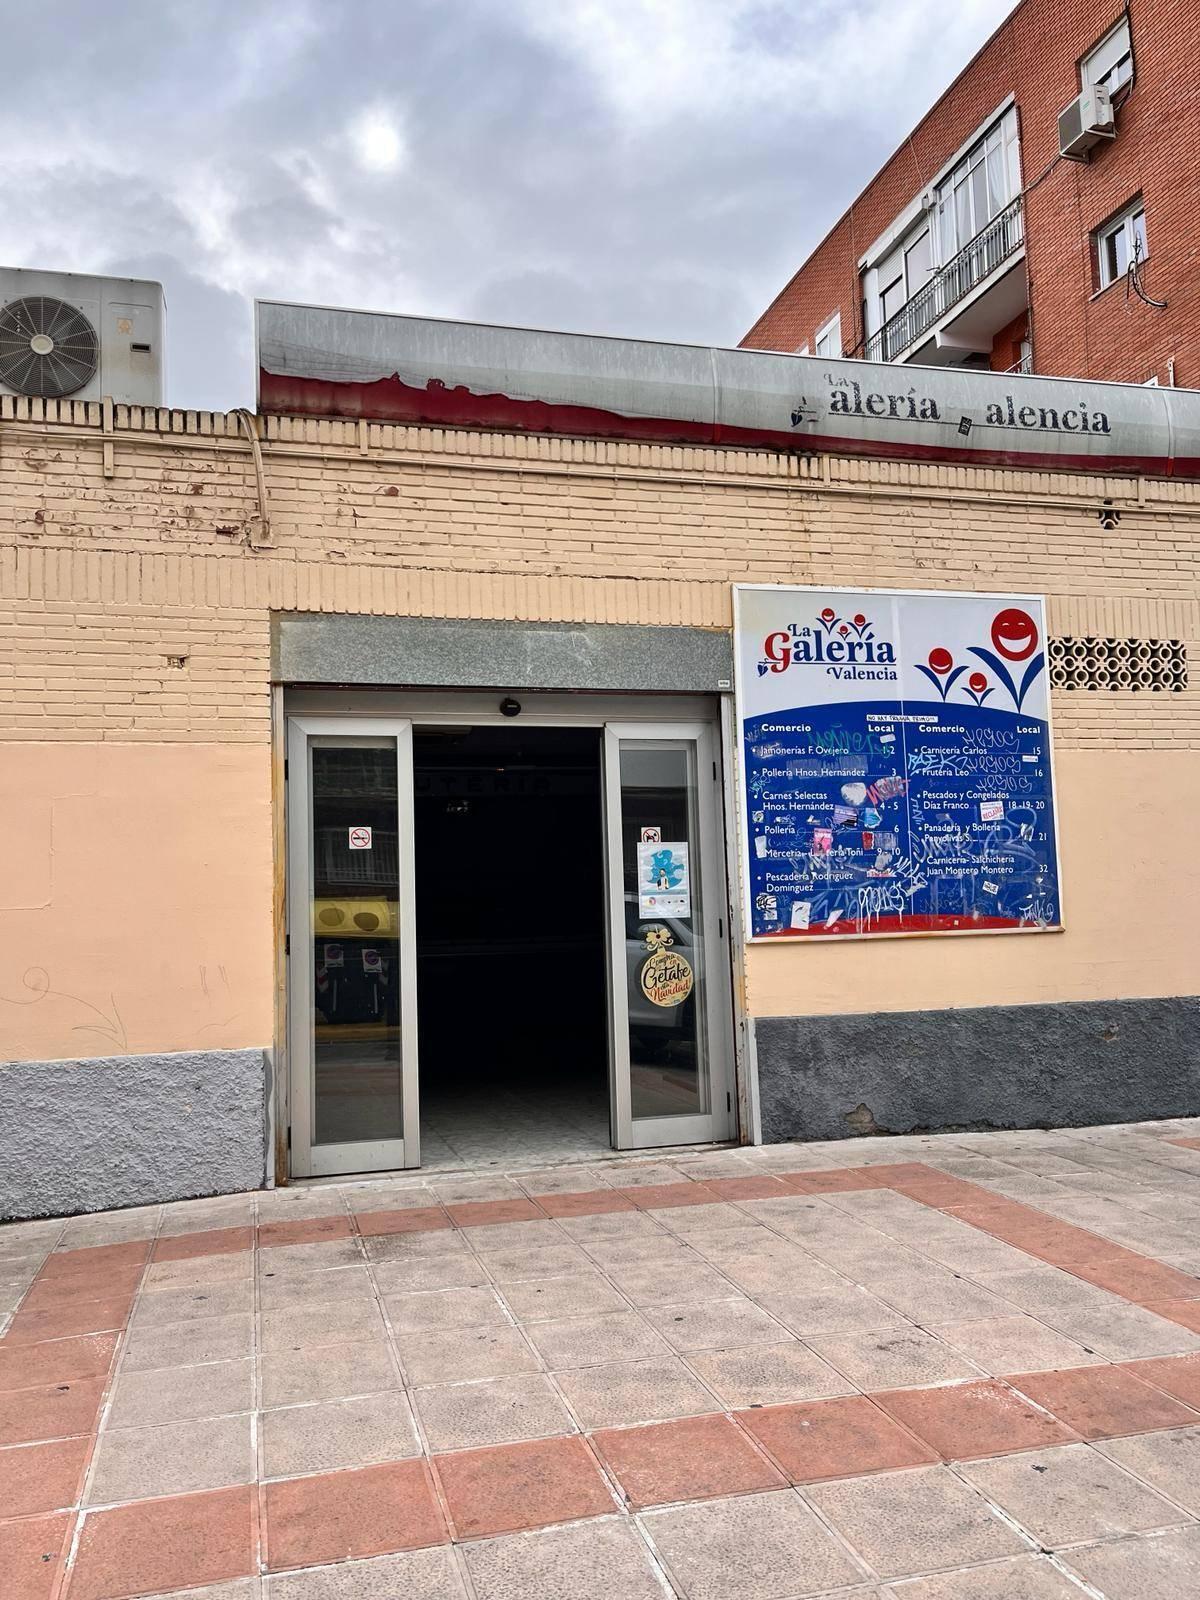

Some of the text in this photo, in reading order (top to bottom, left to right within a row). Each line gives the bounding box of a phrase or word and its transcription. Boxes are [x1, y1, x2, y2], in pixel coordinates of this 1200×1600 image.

[787, 623, 811, 637] La
[764, 629, 897, 674] Galería
[826, 667, 898, 681] Valencia
[761, 723, 895, 733] Comercio Local
[918, 724, 1041, 734] Comercio Local
[760, 745, 806, 756] Jamonerías
[808, 746, 815, 755] F.
[815, 746, 850, 756] Ovejero
[920, 746, 1041, 755] Carnicería Carlos 15
[762, 768, 897, 777] Pollería Hnos. Hernández 3
[922, 768, 1044, 777] Frutería Leo 16
[414, 776, 552, 793] UTERIA
[762, 791, 828, 800] Carnes Selectas
[922, 790, 1010, 801] Pescados y Congelados
[763, 802, 788, 811] Hnos.
[789, 802, 835, 811] Hernández
[879, 802, 886, 811] 4
[893, 803, 899, 811] 5
[923, 801, 941, 810] Díaz
[943, 801, 970, 810] Franco
[1008, 801, 1017, 809] 18
[1035, 801, 1045, 809] 20
[764, 824, 900, 835] Pollería 6
[923, 822, 1001, 833] Panadería y Bollería
[1038, 832, 1047, 841] 21
[846, 847, 864, 856] Toñi
[877, 847, 882, 856] 9
[891, 847, 901, 856] 10
[971, 855, 1015, 864] Salchichería
[926, 864, 1049, 878] Juan Montero Montero 32
[765, 872, 810, 882] Pescadería
[766, 882, 814, 894] Domínguez
[643, 962, 691, 990] Getafe
